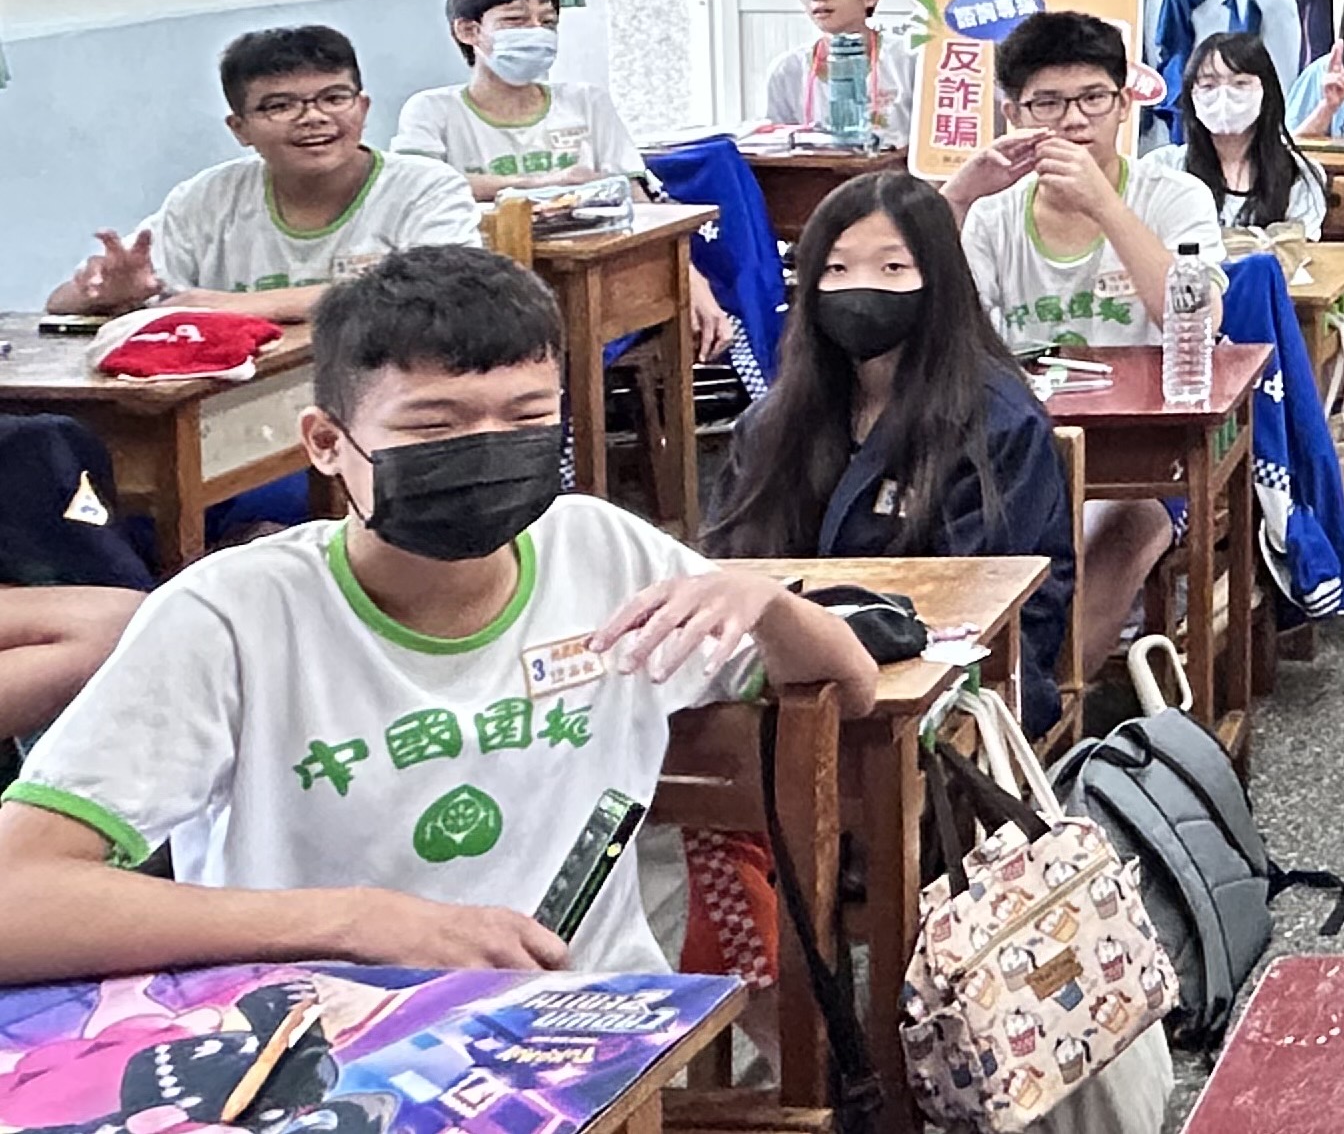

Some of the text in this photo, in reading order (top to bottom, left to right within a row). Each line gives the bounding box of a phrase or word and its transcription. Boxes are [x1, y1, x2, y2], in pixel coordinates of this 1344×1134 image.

[933, 41, 982, 149] 反詐騙
[532, 658, 546, 682] 3
